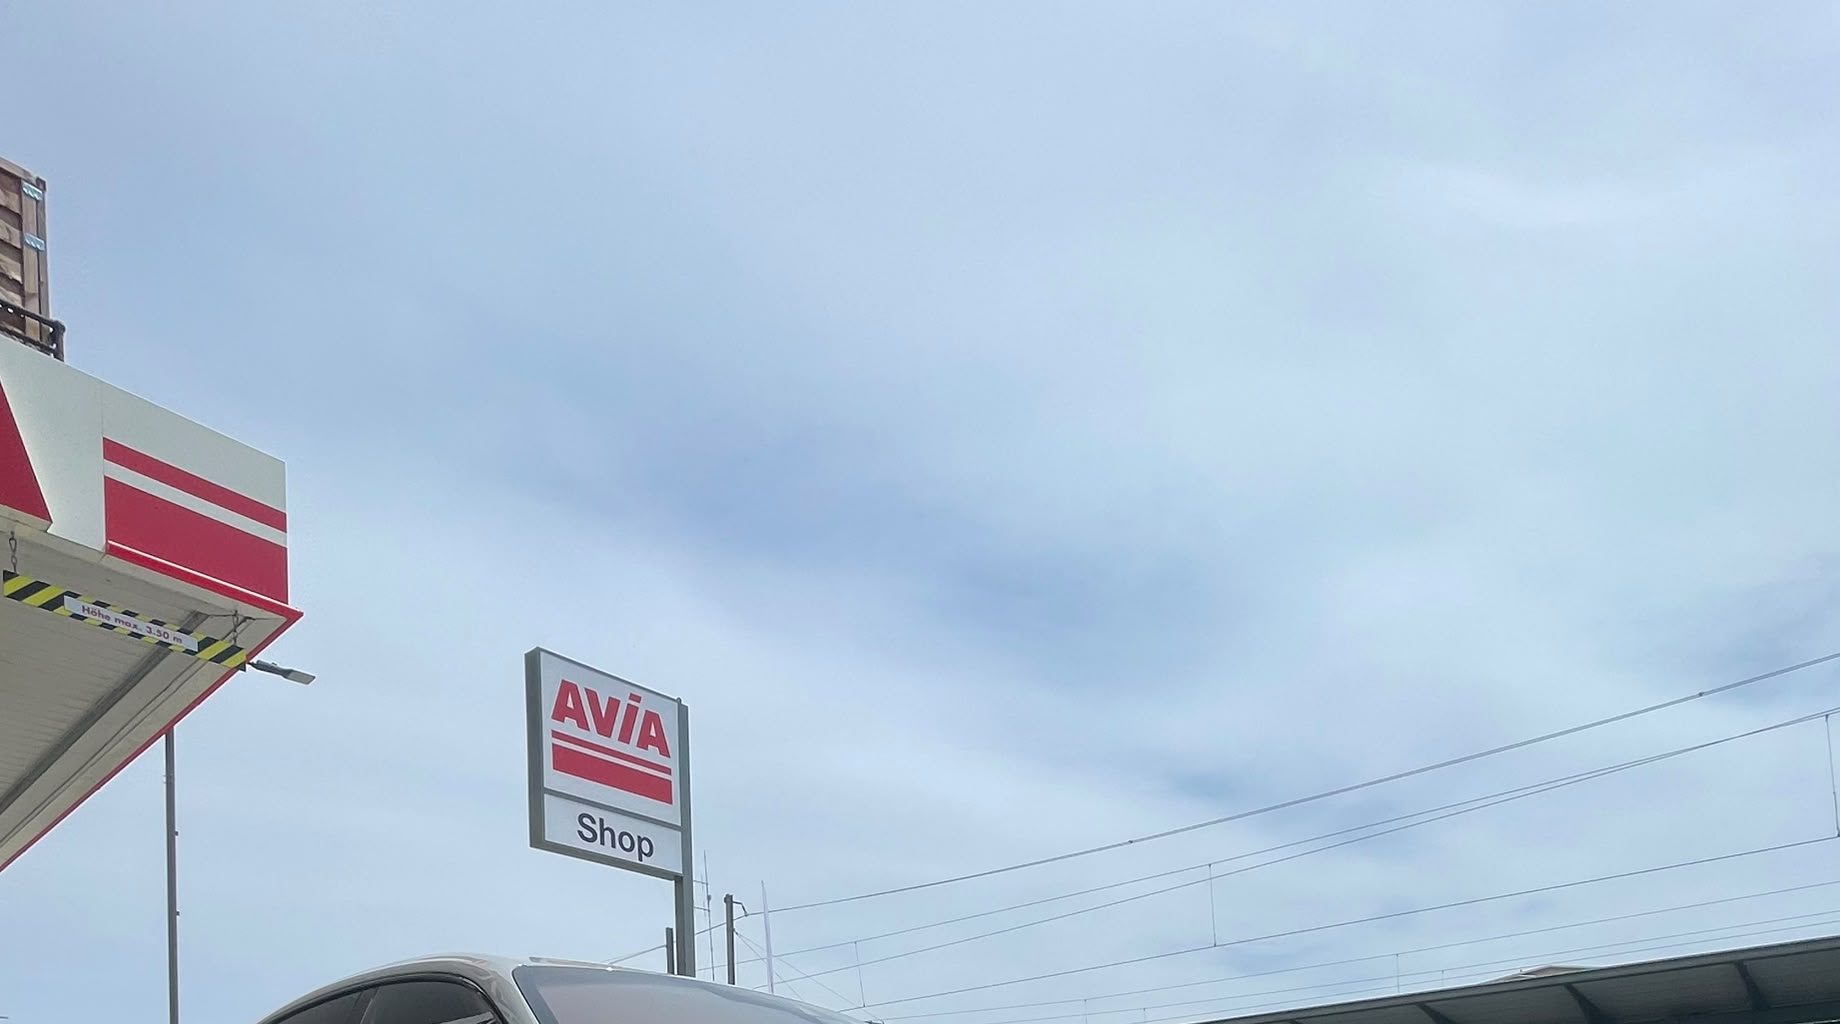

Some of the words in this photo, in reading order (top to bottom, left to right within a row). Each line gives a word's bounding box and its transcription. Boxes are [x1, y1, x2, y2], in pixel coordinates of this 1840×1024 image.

[81, 605, 111, 621] Höhe
[114, 617, 143, 631] max.
[145, 625, 170, 640] 3.50
[173, 635, 183, 644] m
[576, 812, 655, 862] Shop
